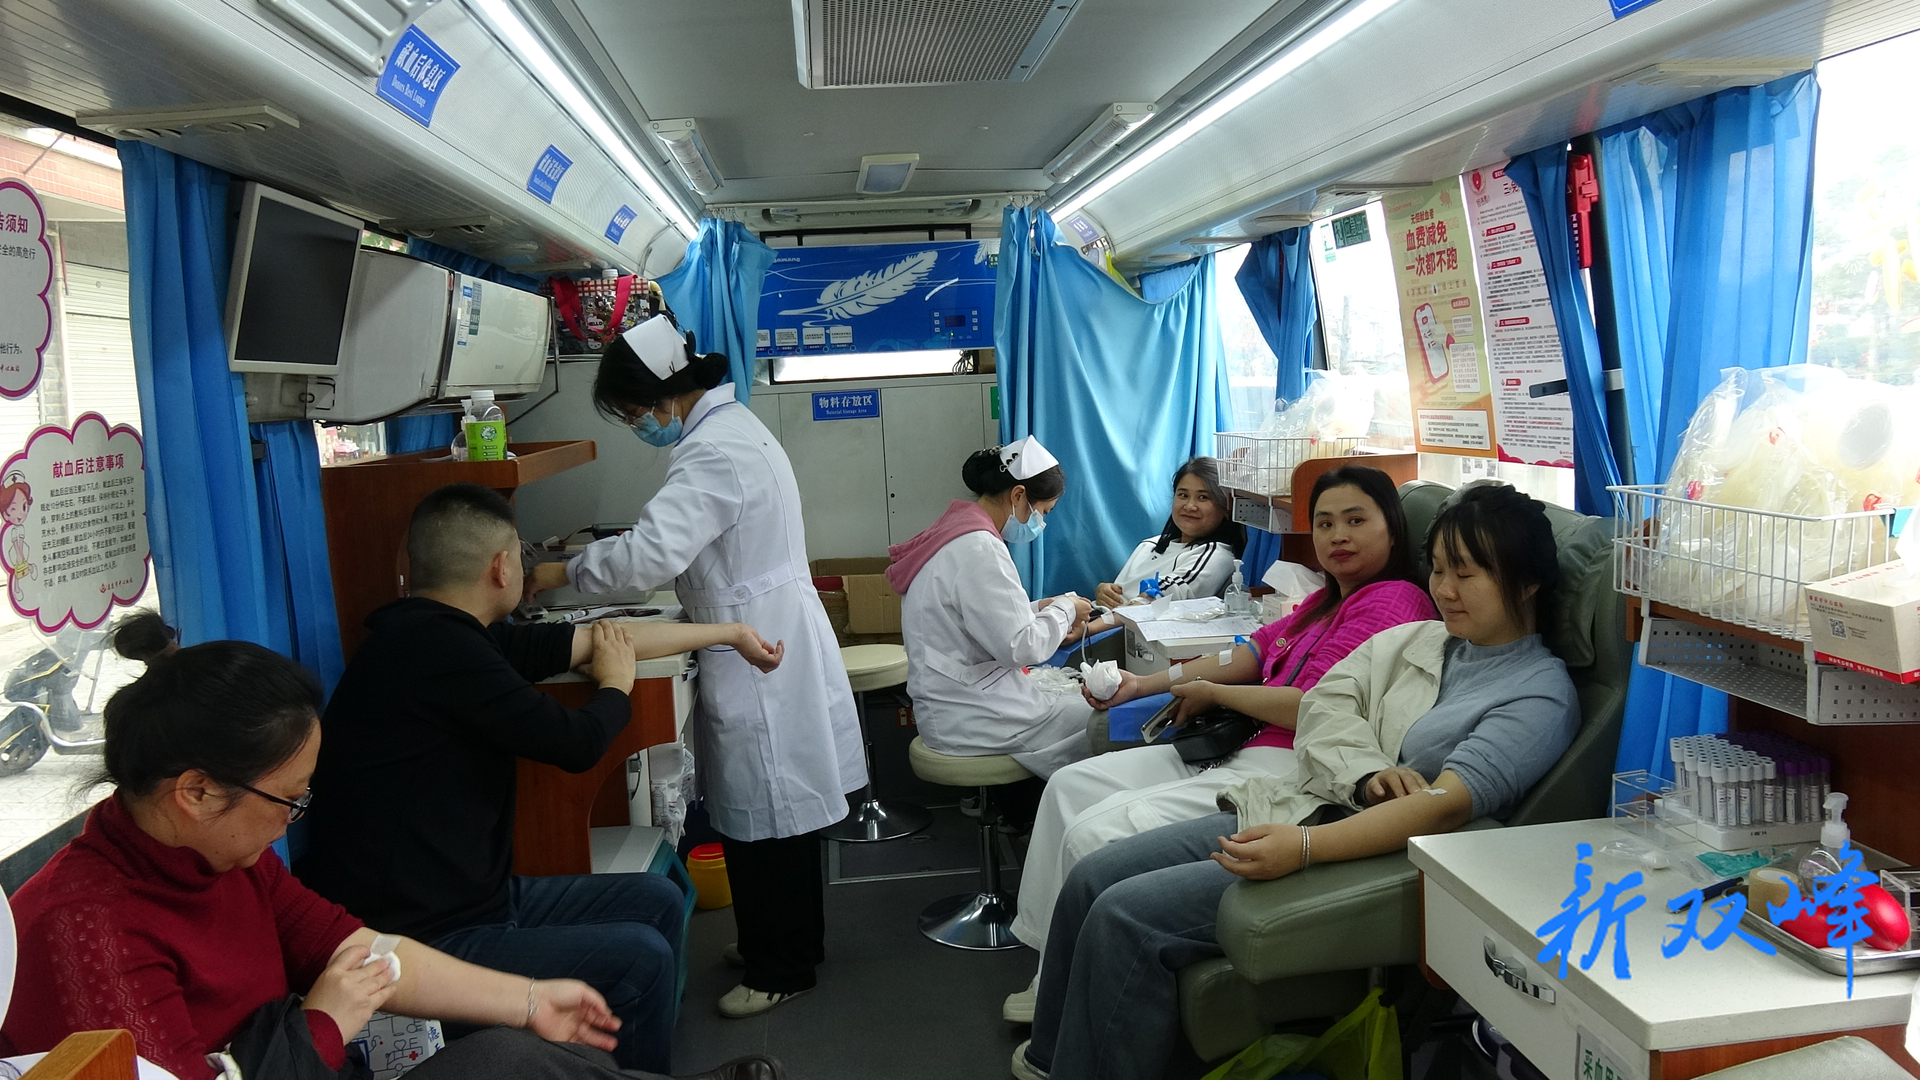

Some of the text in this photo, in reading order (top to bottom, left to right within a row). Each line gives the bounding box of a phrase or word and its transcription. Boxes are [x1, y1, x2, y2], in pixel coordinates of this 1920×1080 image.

[394, 41, 447, 92] 献血后休息区
[1406, 220, 1448, 251] 血费减免
[0, 244, 36, 260] 全的高危行
[1405, 247, 1459, 277] 一次都不跑
[818, 394, 873, 408] 物料存放区
[52, 453, 125, 480] 献血后注意事项
[1583, 1049, 1624, 1080] 采血
